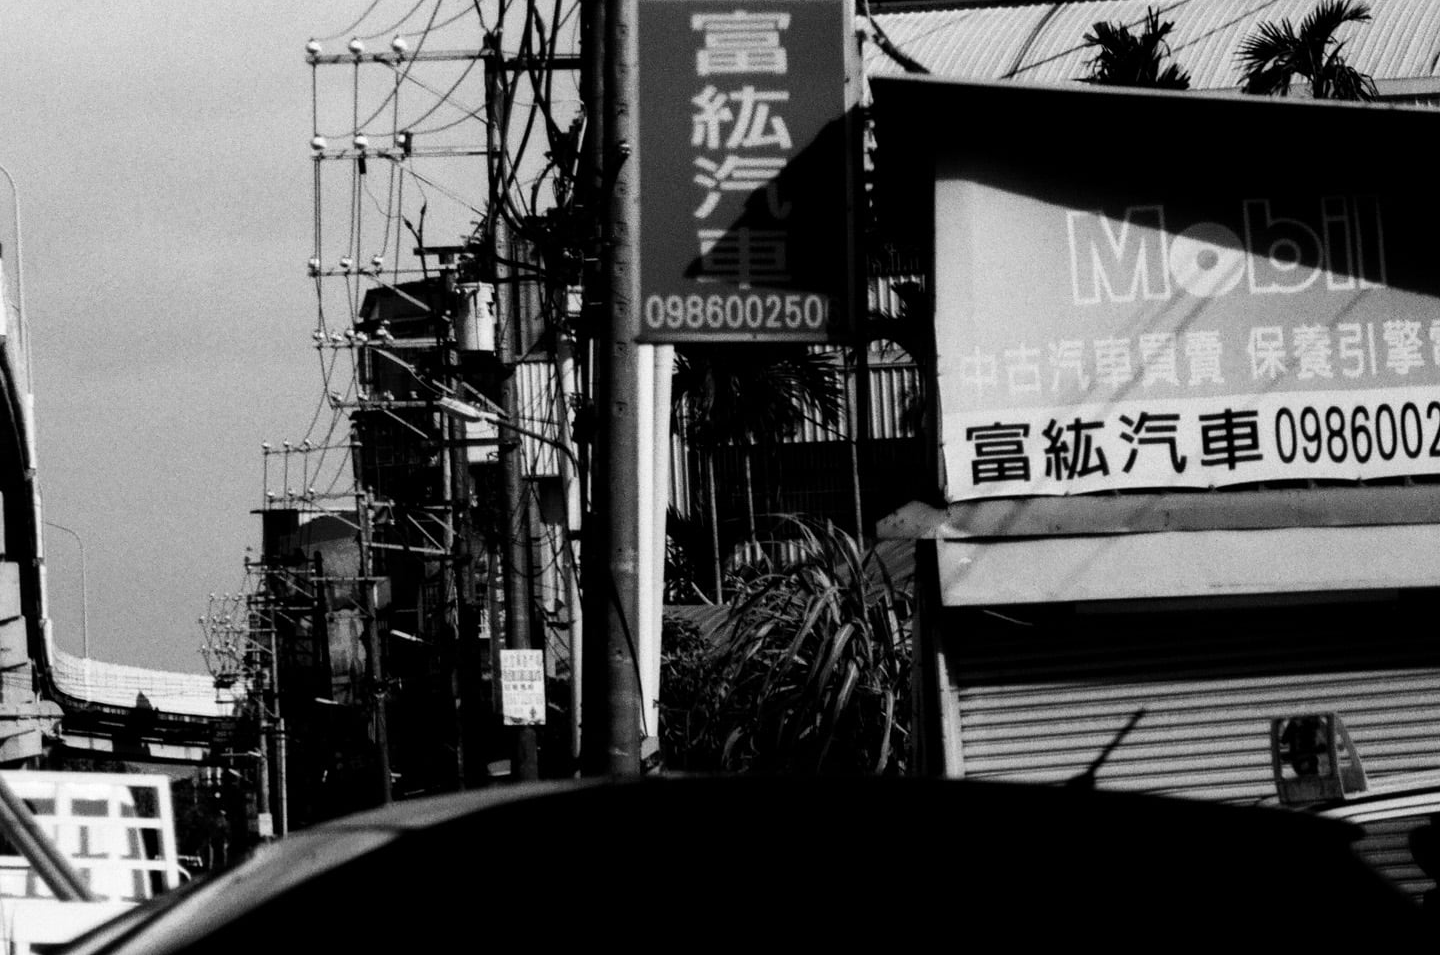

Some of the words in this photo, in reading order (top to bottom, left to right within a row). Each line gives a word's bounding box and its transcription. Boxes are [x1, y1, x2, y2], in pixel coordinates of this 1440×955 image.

[690, 10, 793, 290] 富紘汽車
[1066, 195, 1388, 305] Mobil
[959, 330, 1225, 396] 中古汽車買賣
[1246, 318, 1440, 381] 保養引擎
[965, 408, 1264, 486] 富紘汽車
[1274, 399, 1440, 464] 0986002
